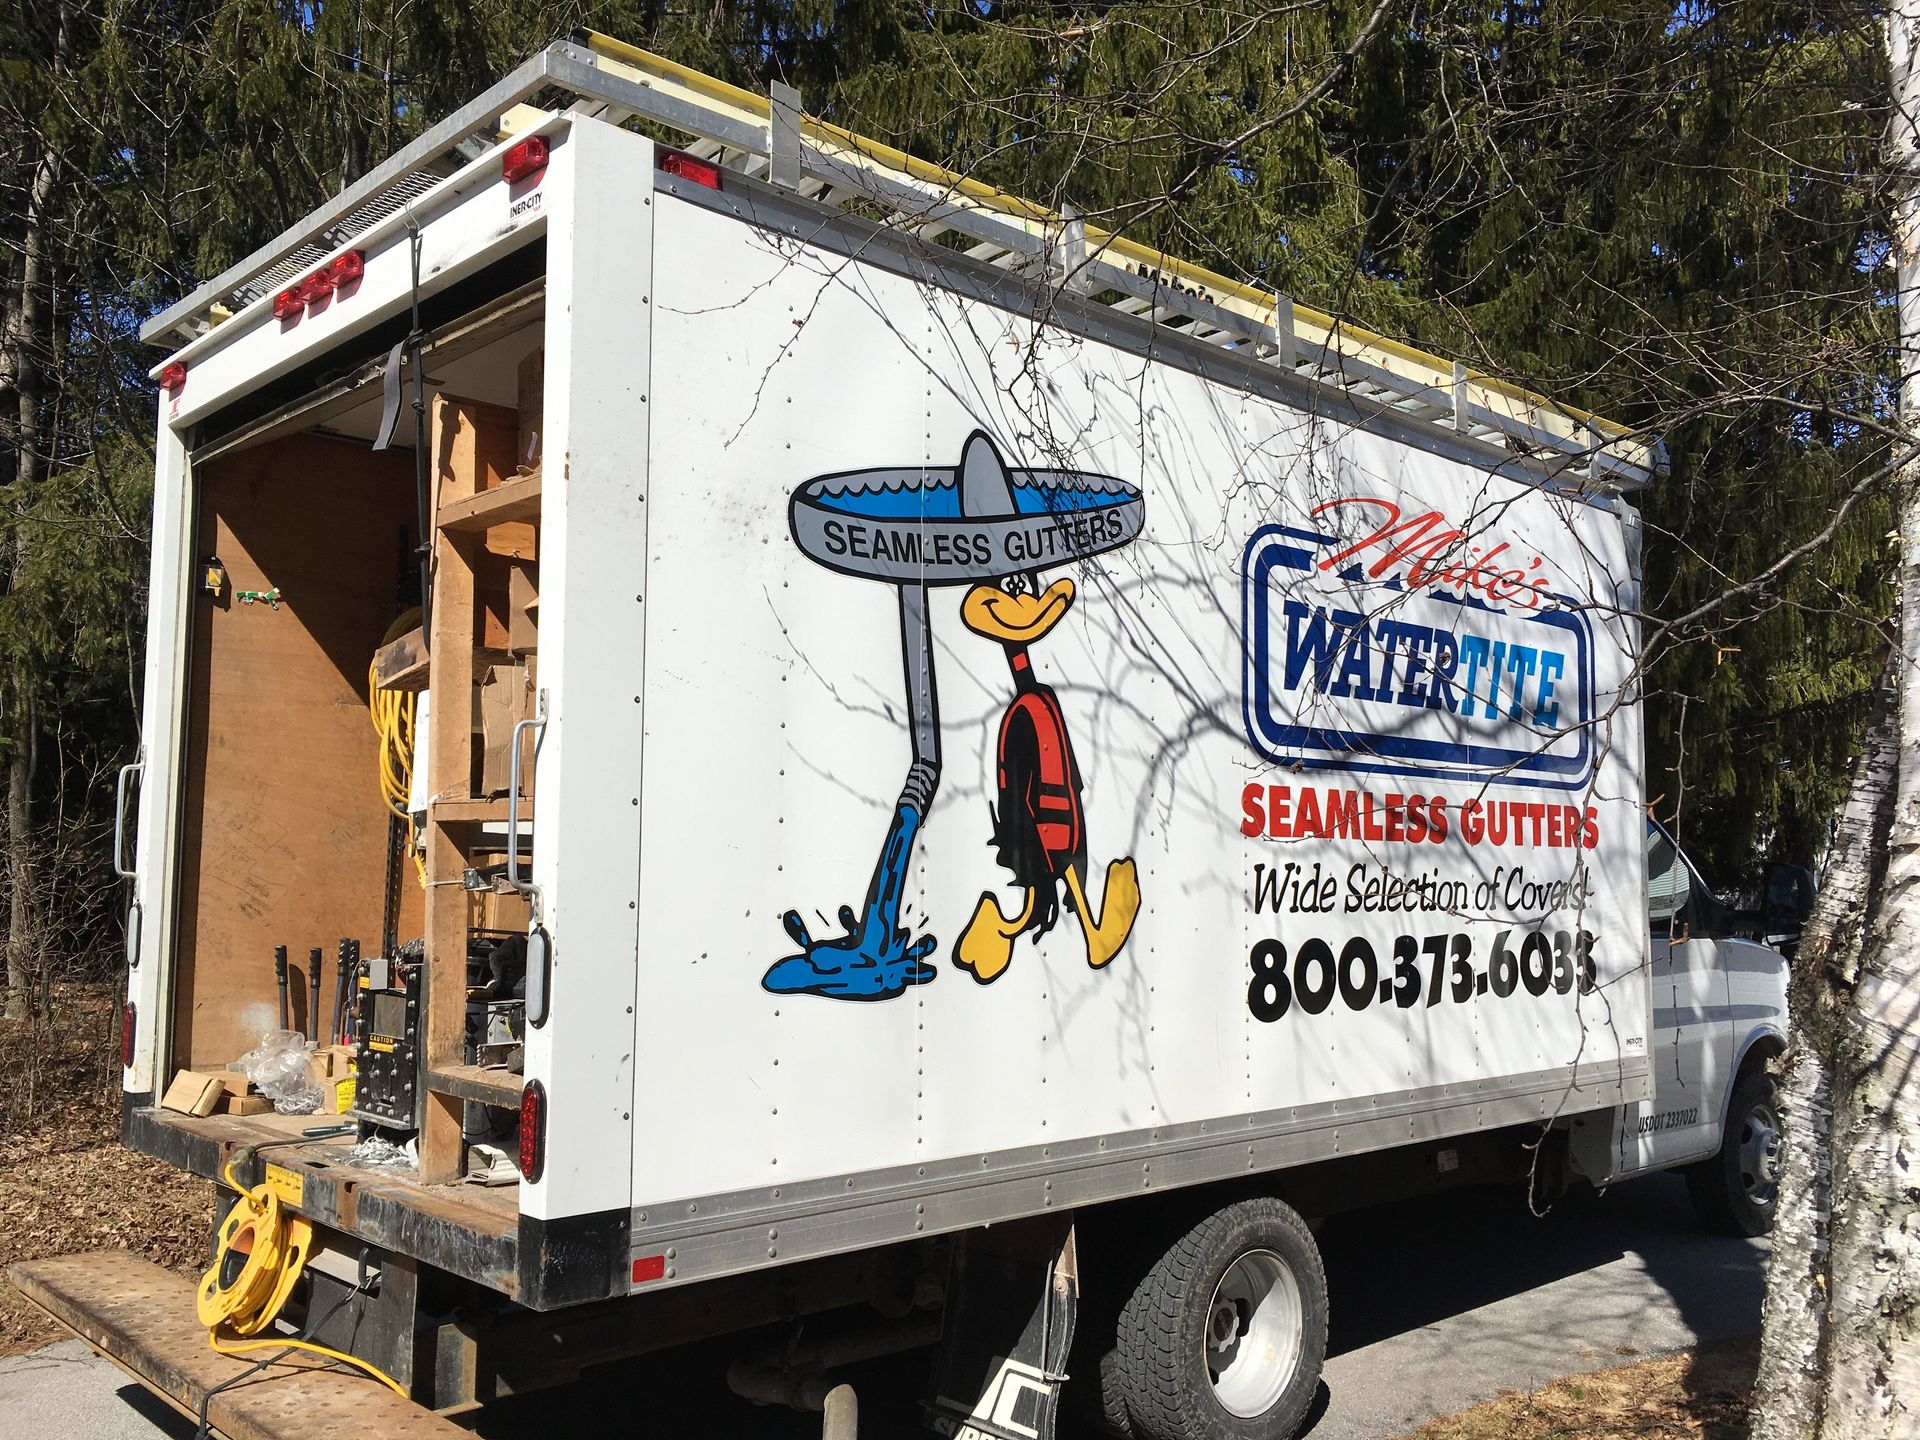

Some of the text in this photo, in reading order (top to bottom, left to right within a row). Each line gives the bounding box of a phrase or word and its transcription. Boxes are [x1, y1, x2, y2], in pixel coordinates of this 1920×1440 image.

[823, 509, 1123, 565] SEAMLESS GUTTERS
[1311, 498, 1550, 609] Mike's
[1239, 783, 1600, 850] SEAMLESS GUTTERS
[1253, 862, 1337, 914] Wide
[1344, 863, 1468, 914] Selection
[1475, 866, 1504, 912] of
[1248, 929, 1598, 1023] 800.373.6033
[369, 1034, 394, 1044] CAUTION
[1638, 1108, 1698, 1133] USDOT 2337022
